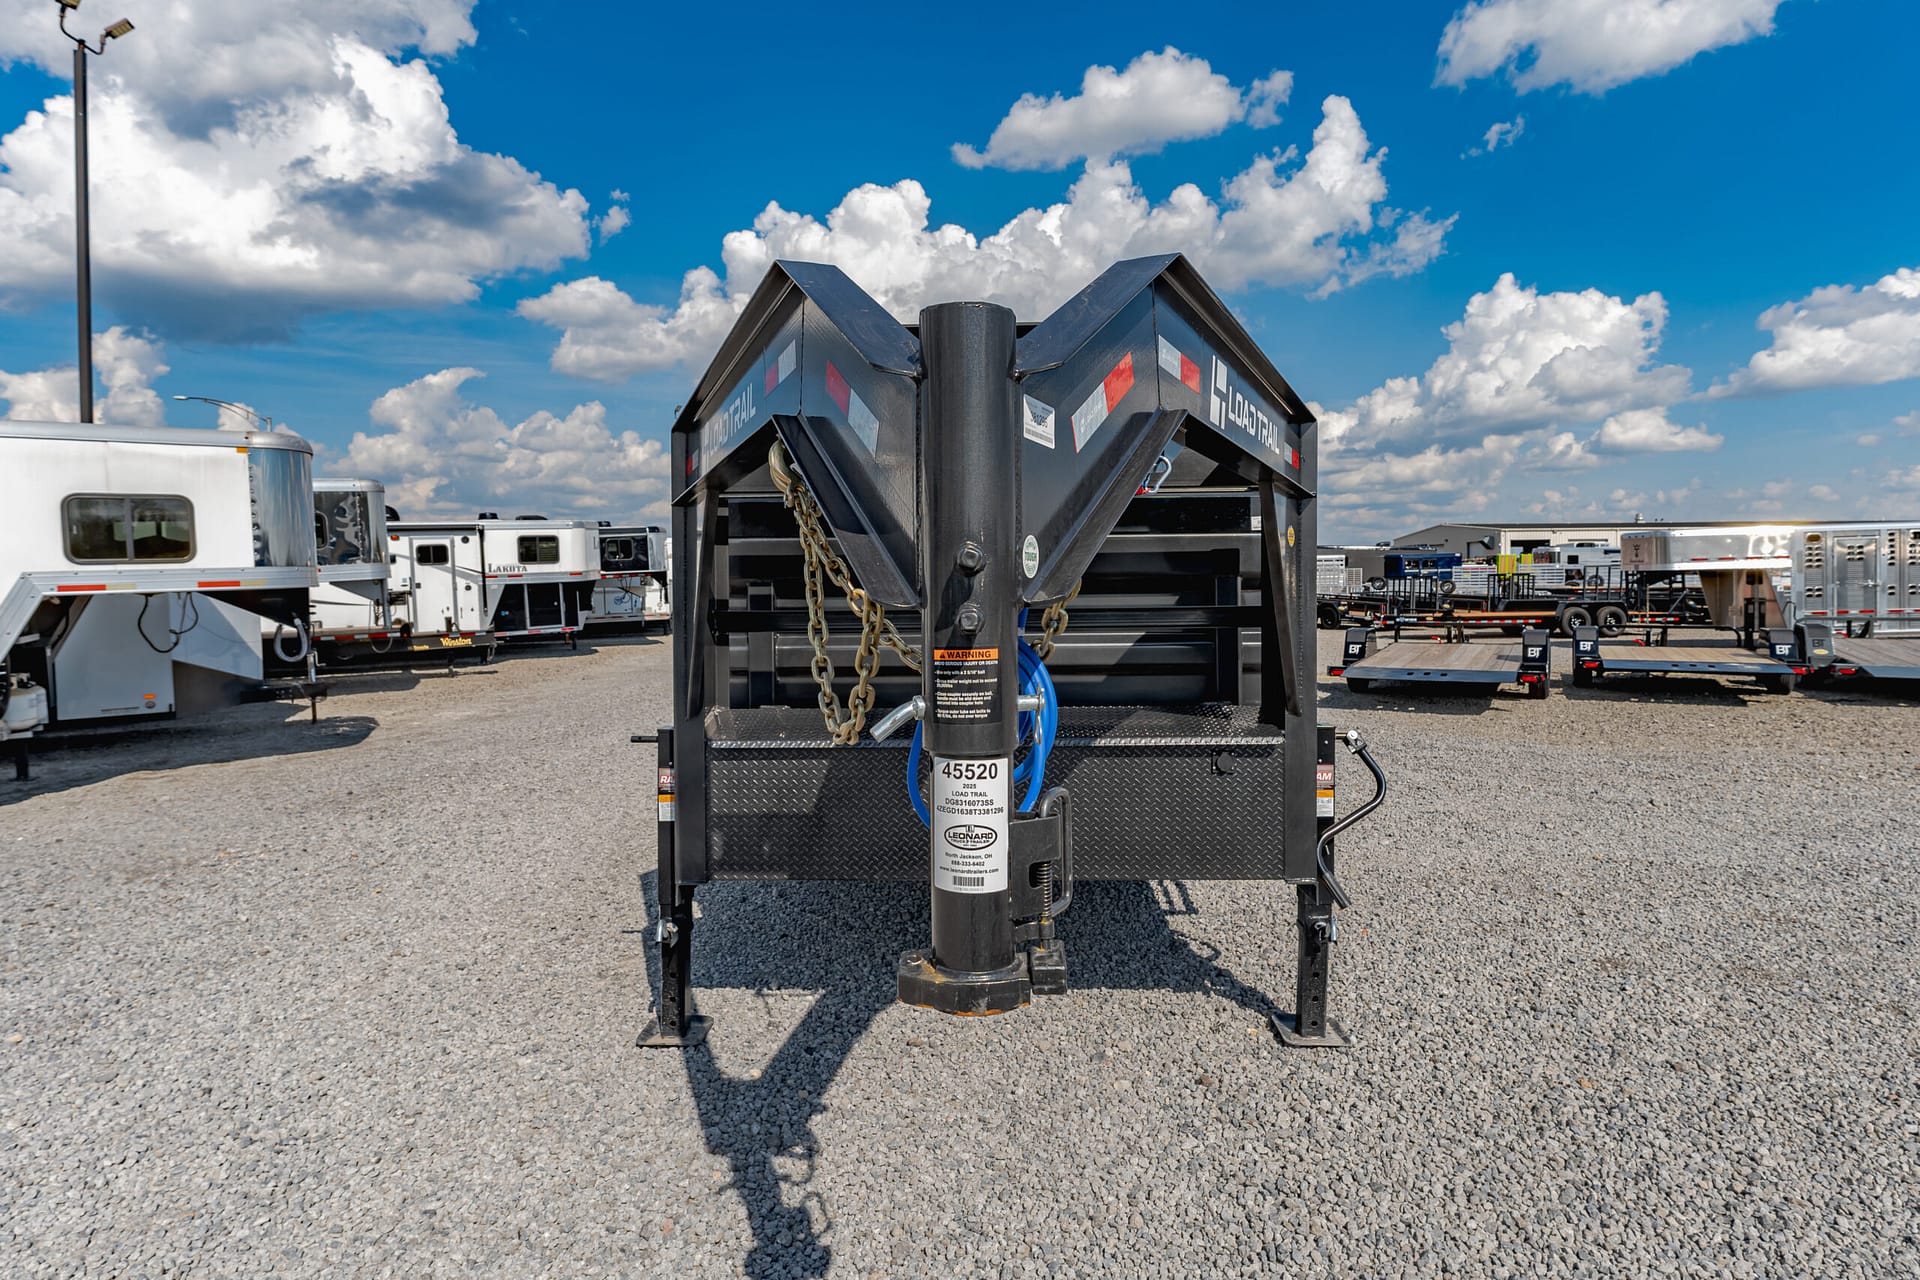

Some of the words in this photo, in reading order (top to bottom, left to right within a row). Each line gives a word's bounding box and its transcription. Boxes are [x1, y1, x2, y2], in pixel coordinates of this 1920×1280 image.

[946, 650, 991, 659] WARNING
[942, 761, 998, 780] 45520
[1316, 772, 1332, 781] AM
[948, 831, 993, 840] LEONARD
[939, 866, 999, 874] www.leonardtrailers.com
